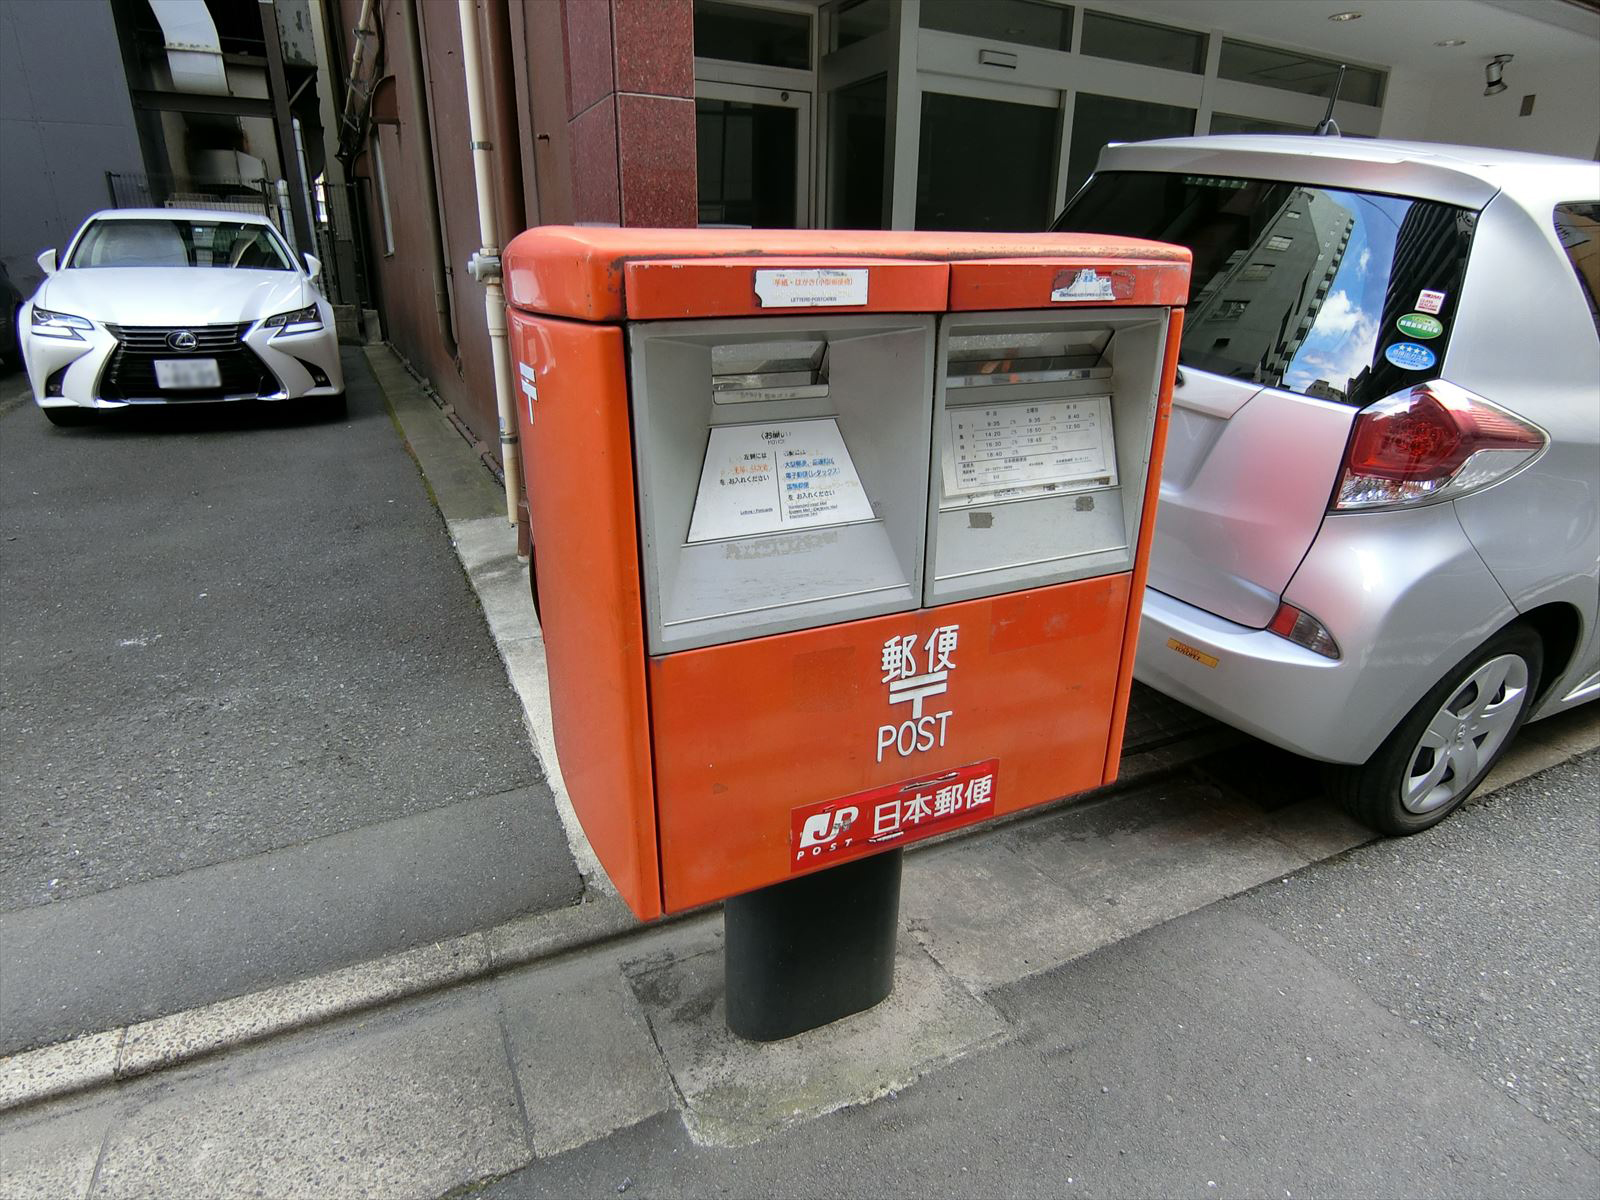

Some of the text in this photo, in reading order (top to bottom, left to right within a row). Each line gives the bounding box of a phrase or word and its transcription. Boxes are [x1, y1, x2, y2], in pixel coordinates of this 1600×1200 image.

[881, 624, 960, 684] 郵便
[876, 710, 953, 763] POST
[873, 774, 992, 834] 日本郵便
[797, 838, 853, 860] POST
